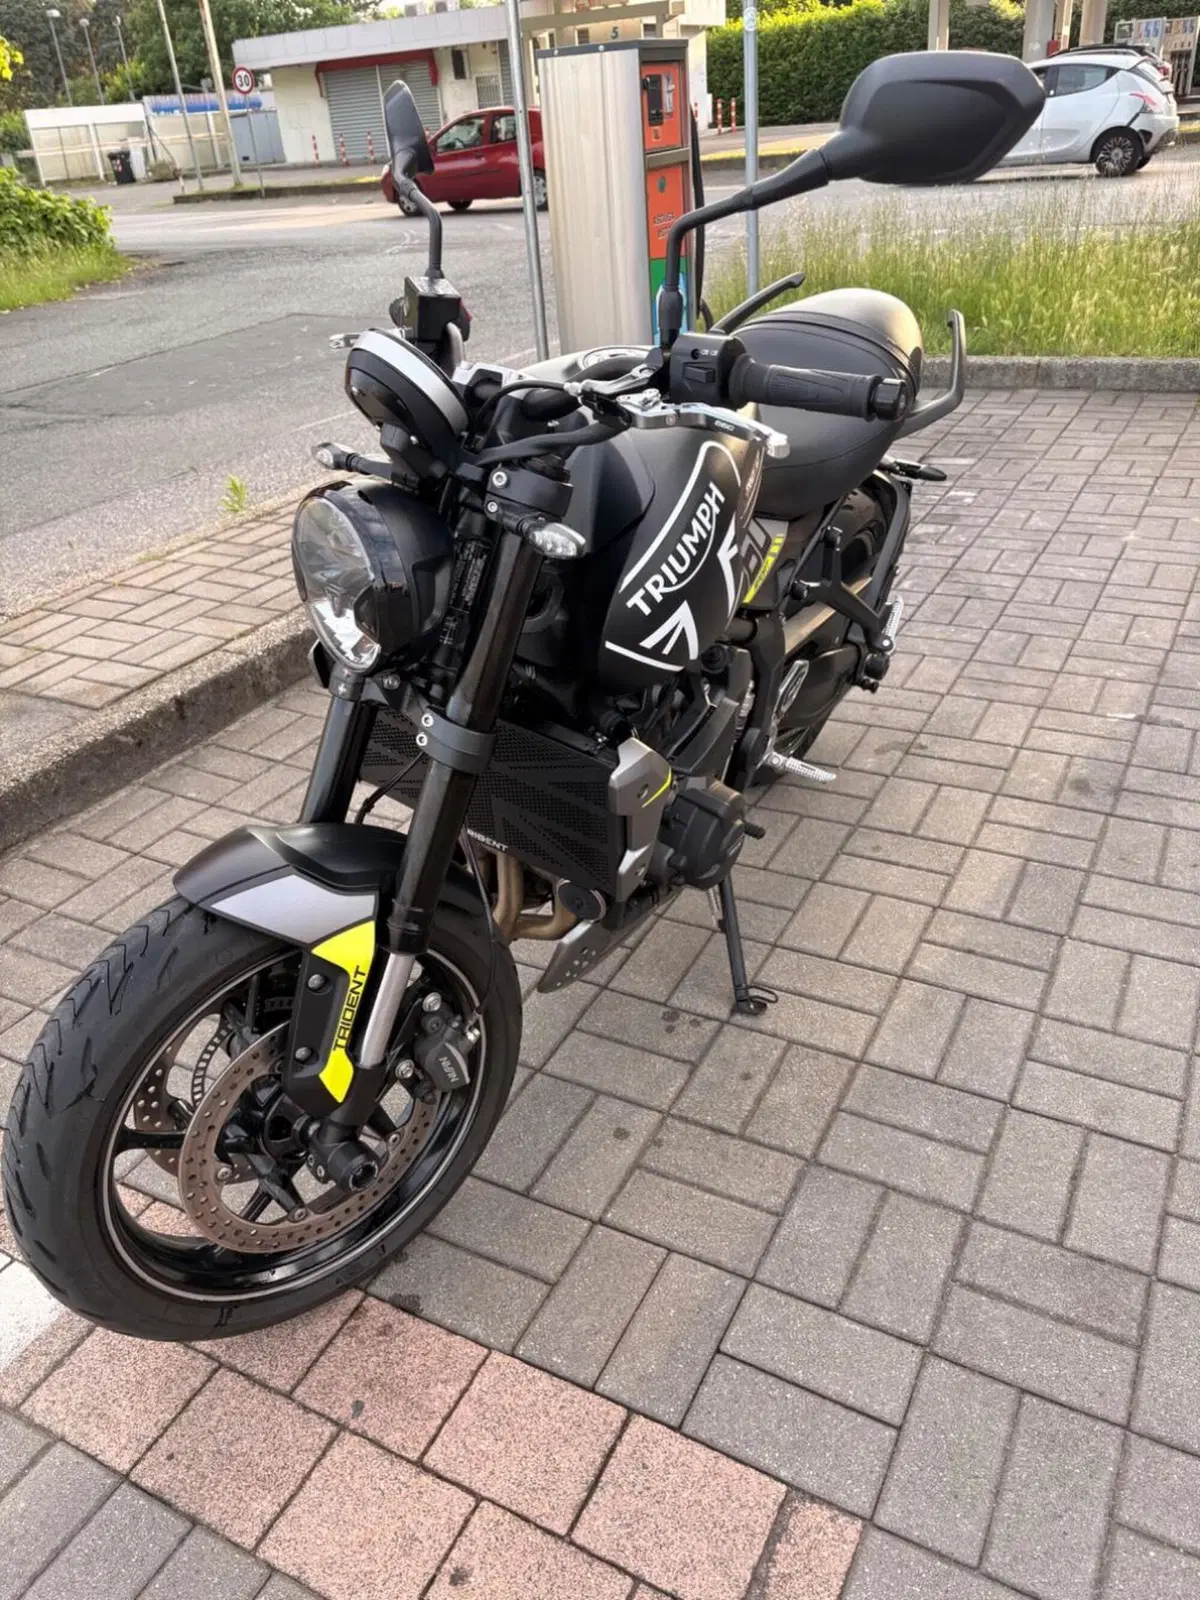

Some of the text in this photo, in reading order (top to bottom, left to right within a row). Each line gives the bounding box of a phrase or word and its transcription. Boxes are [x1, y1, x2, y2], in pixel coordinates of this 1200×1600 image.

[610, 26, 619, 40] 5
[236, 74, 250, 88] 30
[626, 481, 726, 617] TRIUMPH
[465, 827, 509, 852] RIDENT
[333, 965, 368, 1052] TRIDENT
